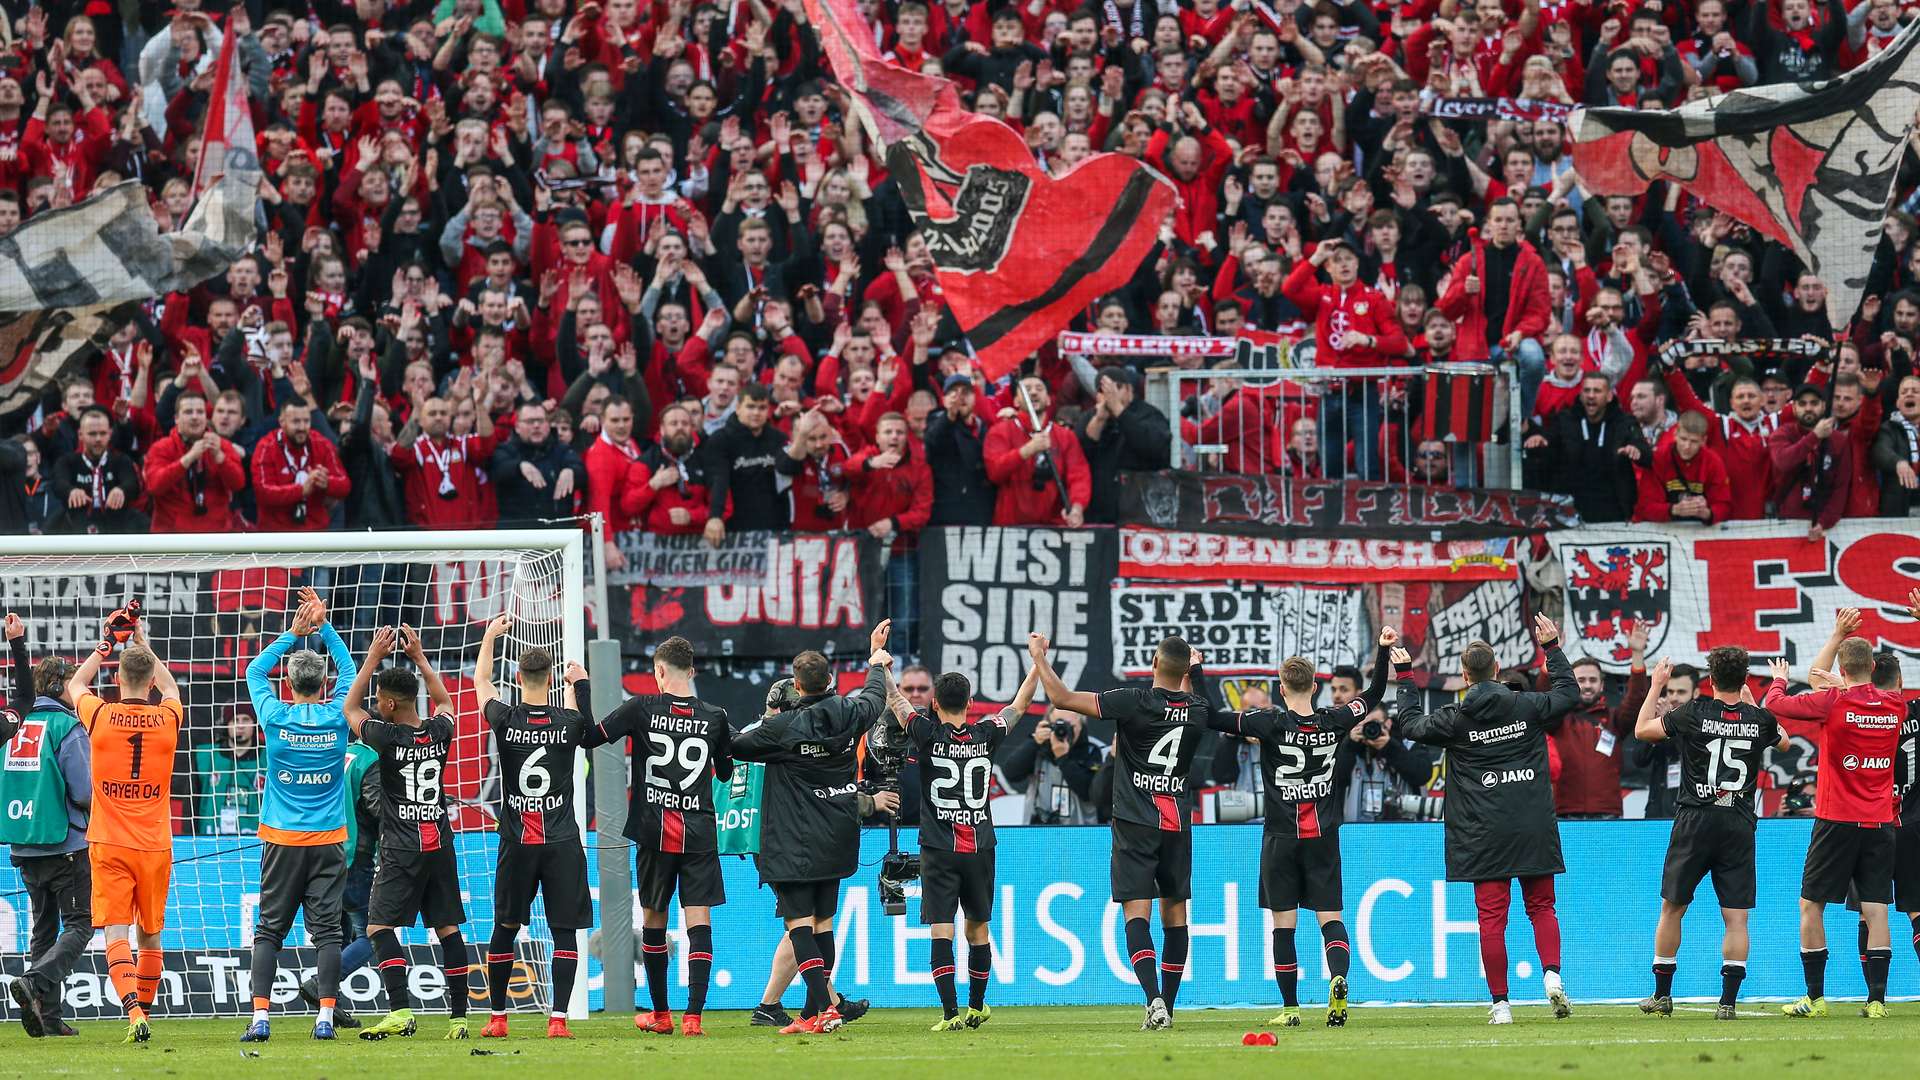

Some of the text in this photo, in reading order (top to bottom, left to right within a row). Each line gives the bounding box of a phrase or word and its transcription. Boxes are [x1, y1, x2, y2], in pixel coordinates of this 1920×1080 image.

[945, 525, 1096, 587] WEST
[1130, 529, 1438, 568] OFFENBACH
[941, 583, 1089, 648] SIDE
[1119, 591, 1271, 623] STADT
[1487, 597, 1522, 645] DIE
[1120, 648, 1271, 667] AUEBEN
[109, 711, 167, 728] HRADECKY
[650, 714, 709, 735] HAVERTZ
[1164, 707, 1189, 722] TAH
[1846, 711, 1899, 724] Barmenia
[279, 729, 338, 743] Barmenia
[505, 726, 568, 744] DRAGOVIĆ
[1284, 730, 1336, 746] WEISER
[1469, 719, 1527, 742] Barmenia
[1482, 730, 1525, 744] Versicherungen
[1701, 718, 1760, 738] BAUMGARTLINGER
[127, 731, 144, 780] 1
[395, 742, 447, 761] WENDELL
[932, 741, 989, 758] CH. ARÁNGUIZ
[1147, 725, 1184, 776] 4
[518, 745, 551, 797] 6
[645, 731, 709, 791] 29
[1274, 742, 1339, 787] 23
[1705, 738, 1753, 791] 15
[1861, 757, 1891, 769] JAKO
[297, 773, 332, 785] JAKO
[399, 759, 441, 805] 18
[930, 756, 992, 809] 20
[1133, 771, 1186, 792] BAYER 04
[1501, 768, 1535, 784] JAKO
[102, 781, 162, 800] BAYER 04
[1280, 783, 1317, 801] BAYER
[8, 800, 33, 820] 04
[398, 804, 434, 821] BAYER
[508, 794, 563, 813] BAYER 04
[682, 795, 700, 811] 04
[715, 807, 759, 831] HOST
[790, 874, 1533, 985] MENSCHLCH.
